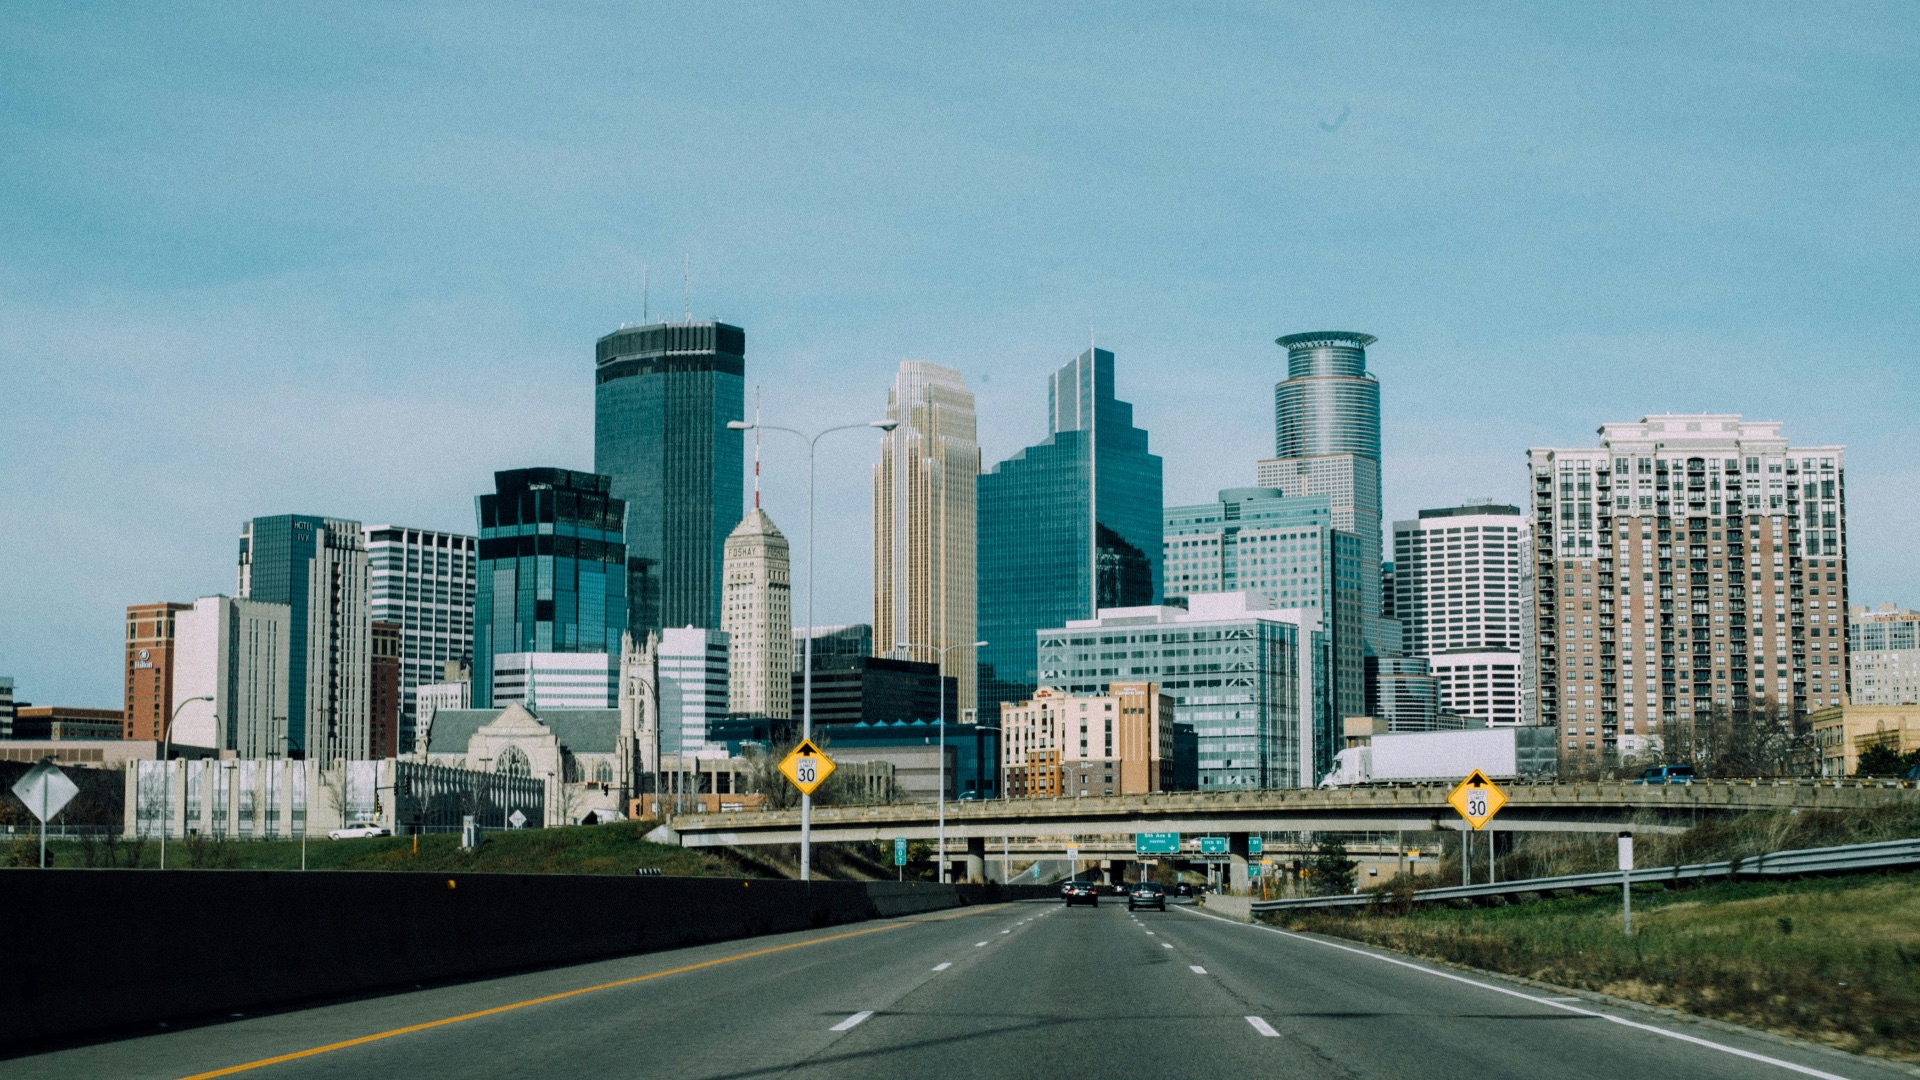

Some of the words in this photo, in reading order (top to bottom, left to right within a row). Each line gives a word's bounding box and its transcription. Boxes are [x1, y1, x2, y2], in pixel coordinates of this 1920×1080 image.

[294, 521, 313, 530] HOTEL
[728, 547, 756, 557] FOSHAY
[767, 547, 787, 557] FOSHAY
[135, 660, 153, 669] Hilton
[798, 768, 815, 782] 30
[1469, 800, 1486, 816] 30
